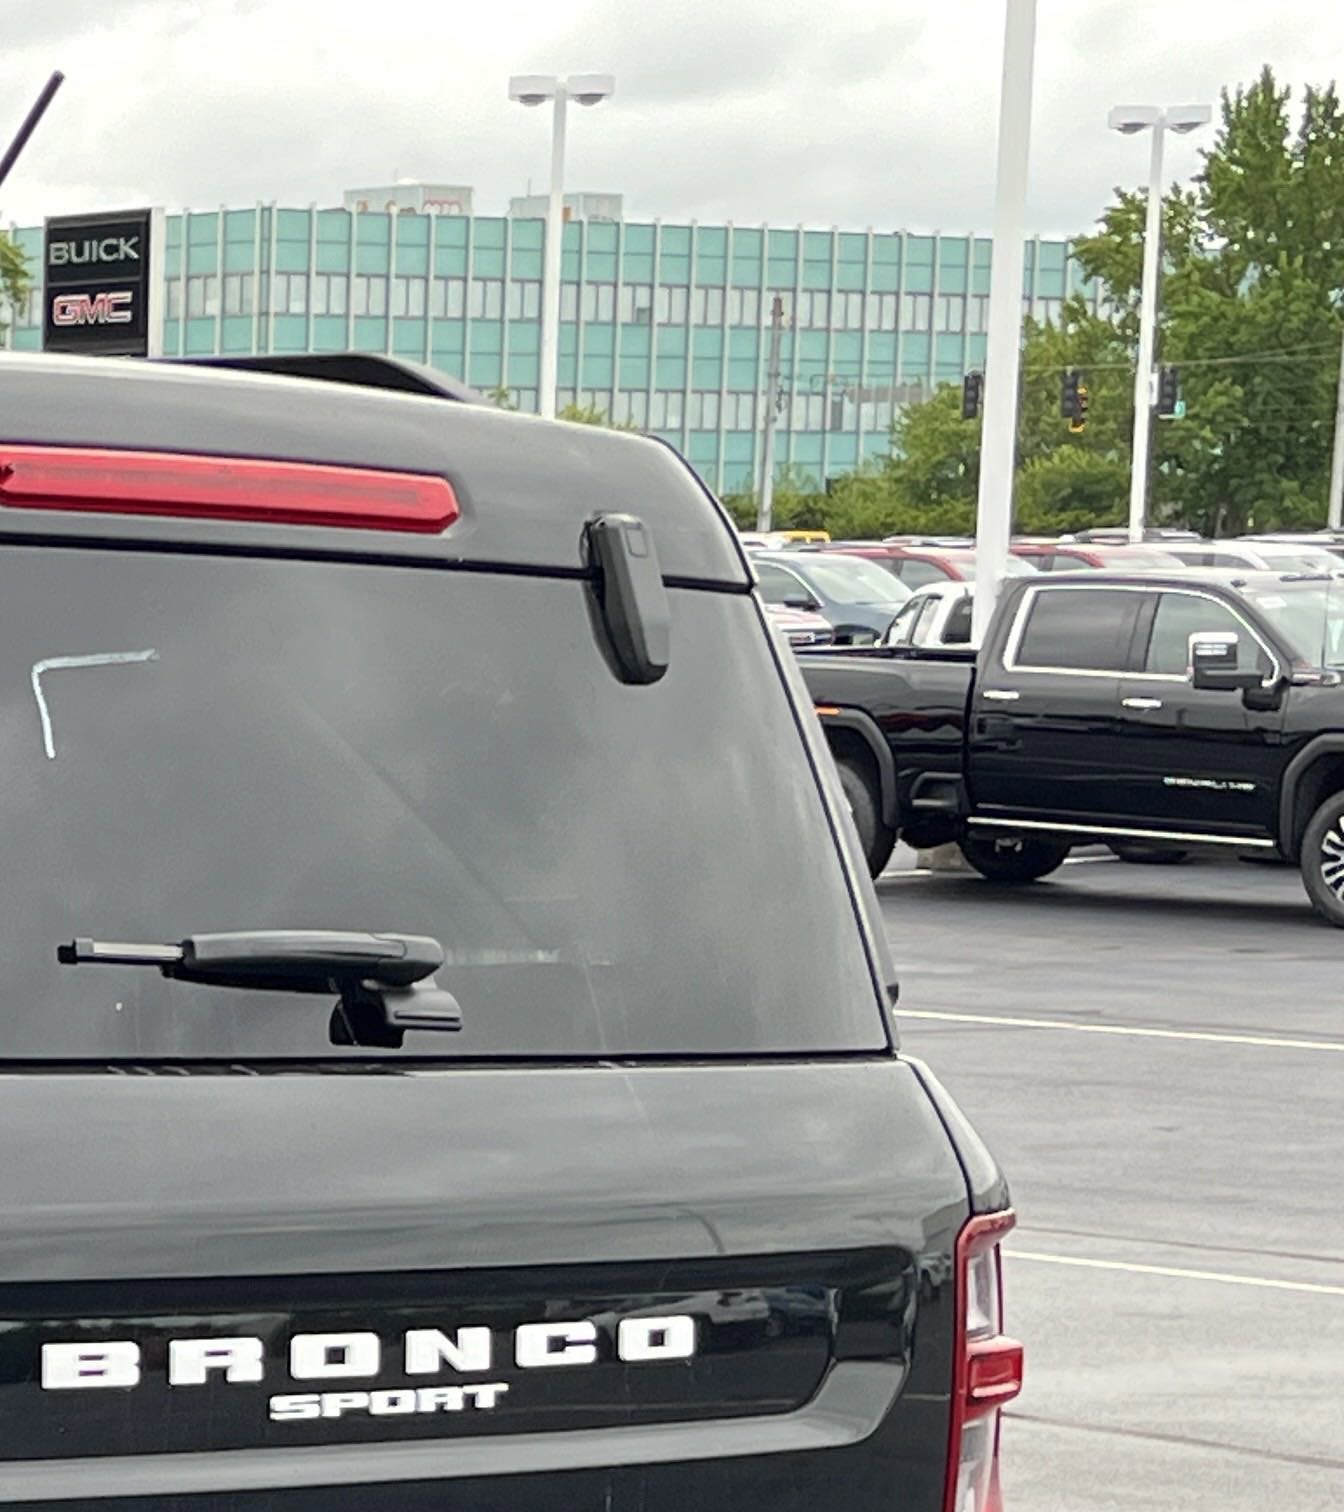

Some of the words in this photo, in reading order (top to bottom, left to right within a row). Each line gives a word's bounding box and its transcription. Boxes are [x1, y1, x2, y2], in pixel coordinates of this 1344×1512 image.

[48, 236, 140, 265] BUICK
[53, 291, 133, 326] GMC
[41, 1315, 695, 1391] BRONCO
[269, 1383, 509, 1421] SPORT
